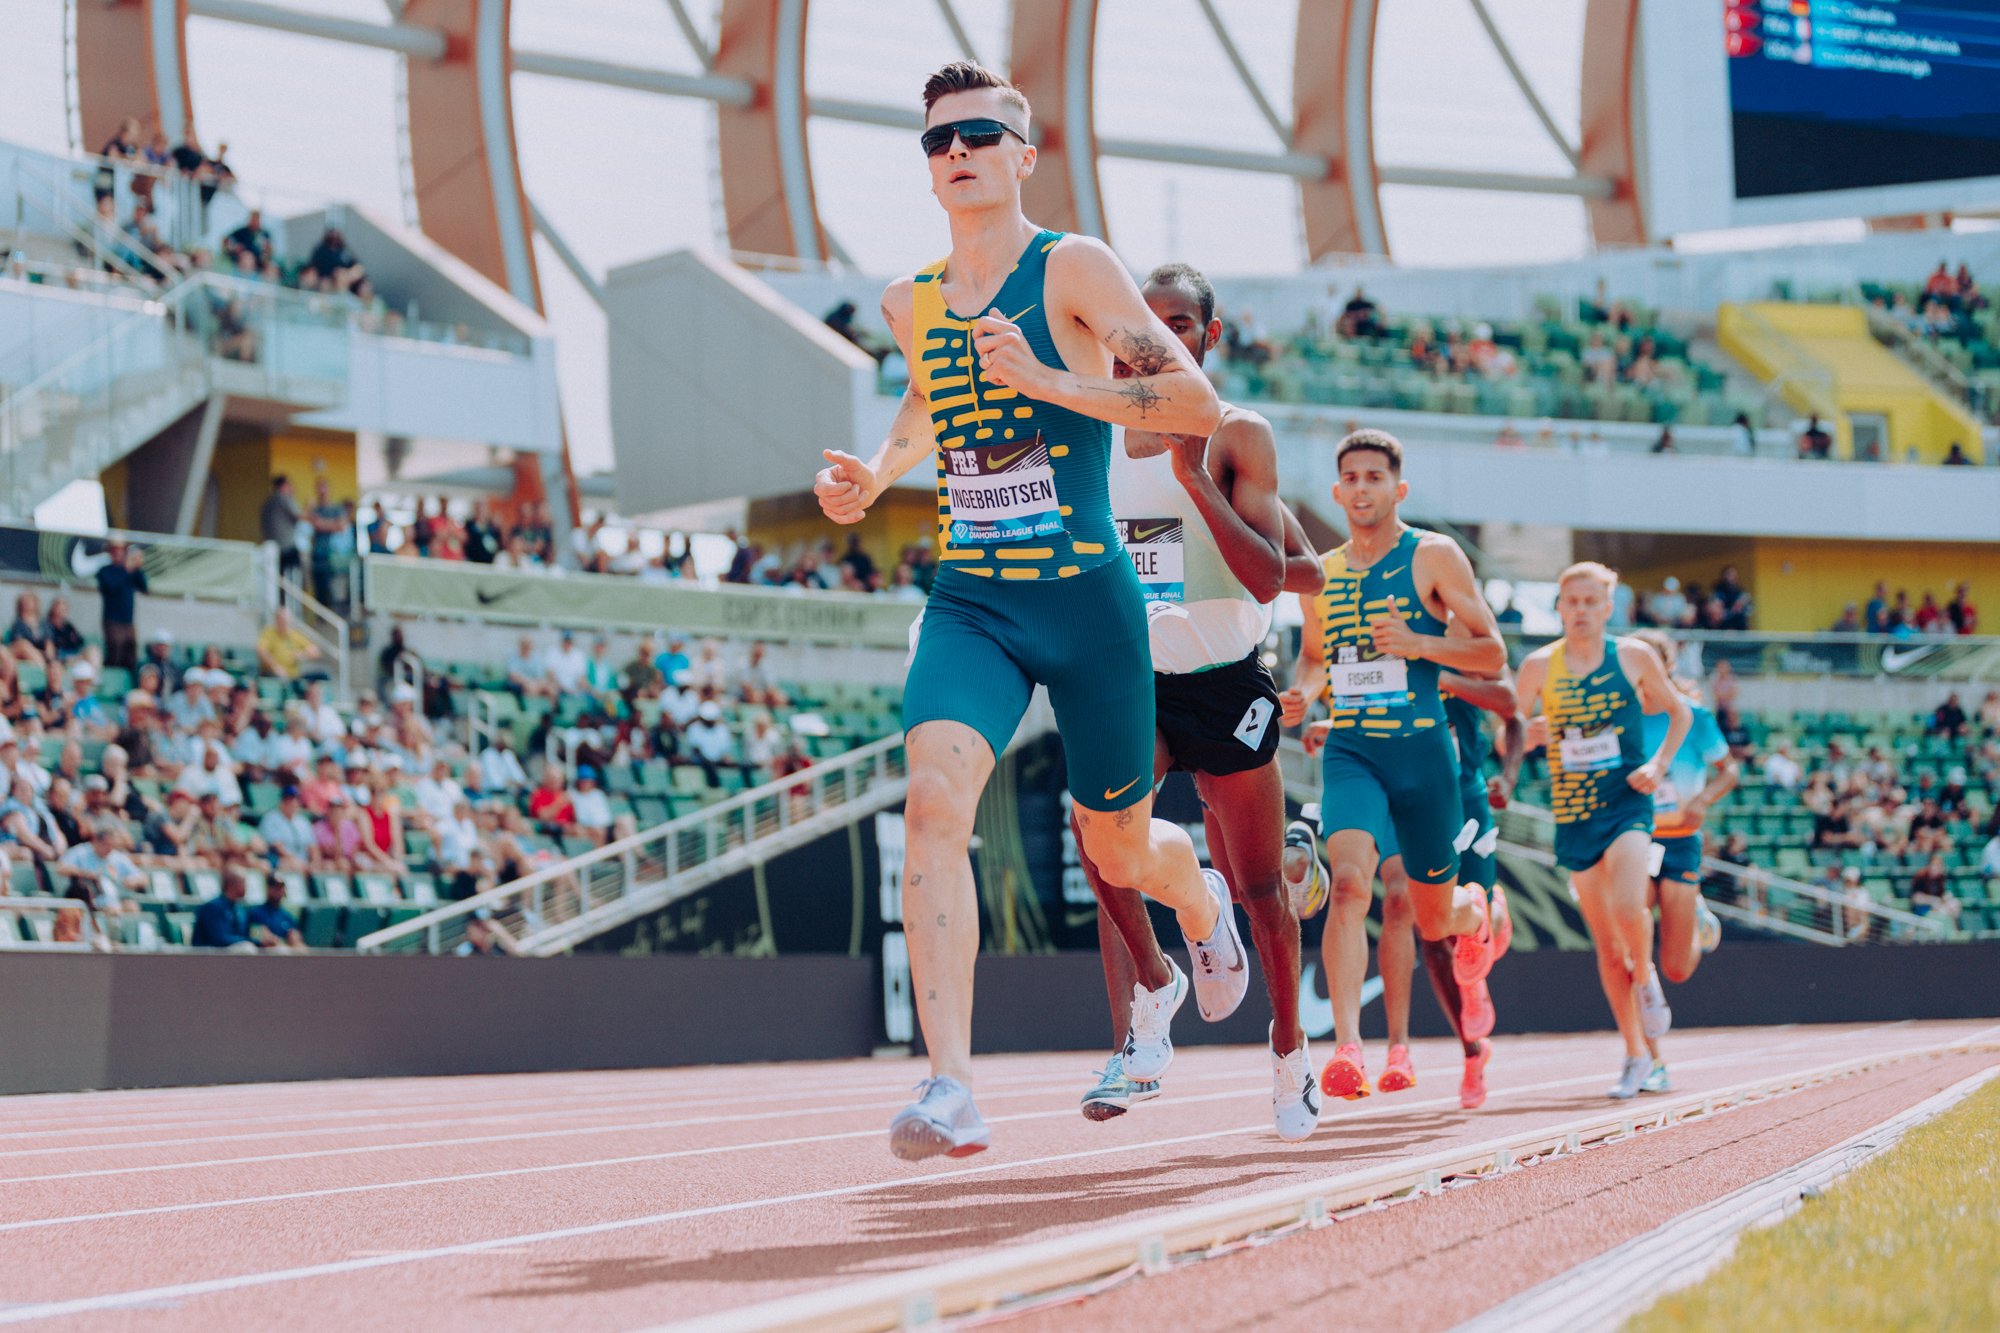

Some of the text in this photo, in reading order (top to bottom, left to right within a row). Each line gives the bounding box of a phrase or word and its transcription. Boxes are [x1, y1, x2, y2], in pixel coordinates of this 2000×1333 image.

[949, 450, 980, 475] PRE
[950, 479, 1053, 510] INGEBRIGTSEN
[969, 521, 1060, 539] DIAMOND LEAGUE FINAL
[1128, 552, 1158, 575] ELE
[1161, 591, 1182, 600] FINAL
[1347, 670, 1385, 687] FISHER
[1245, 708, 1259, 733] 2
